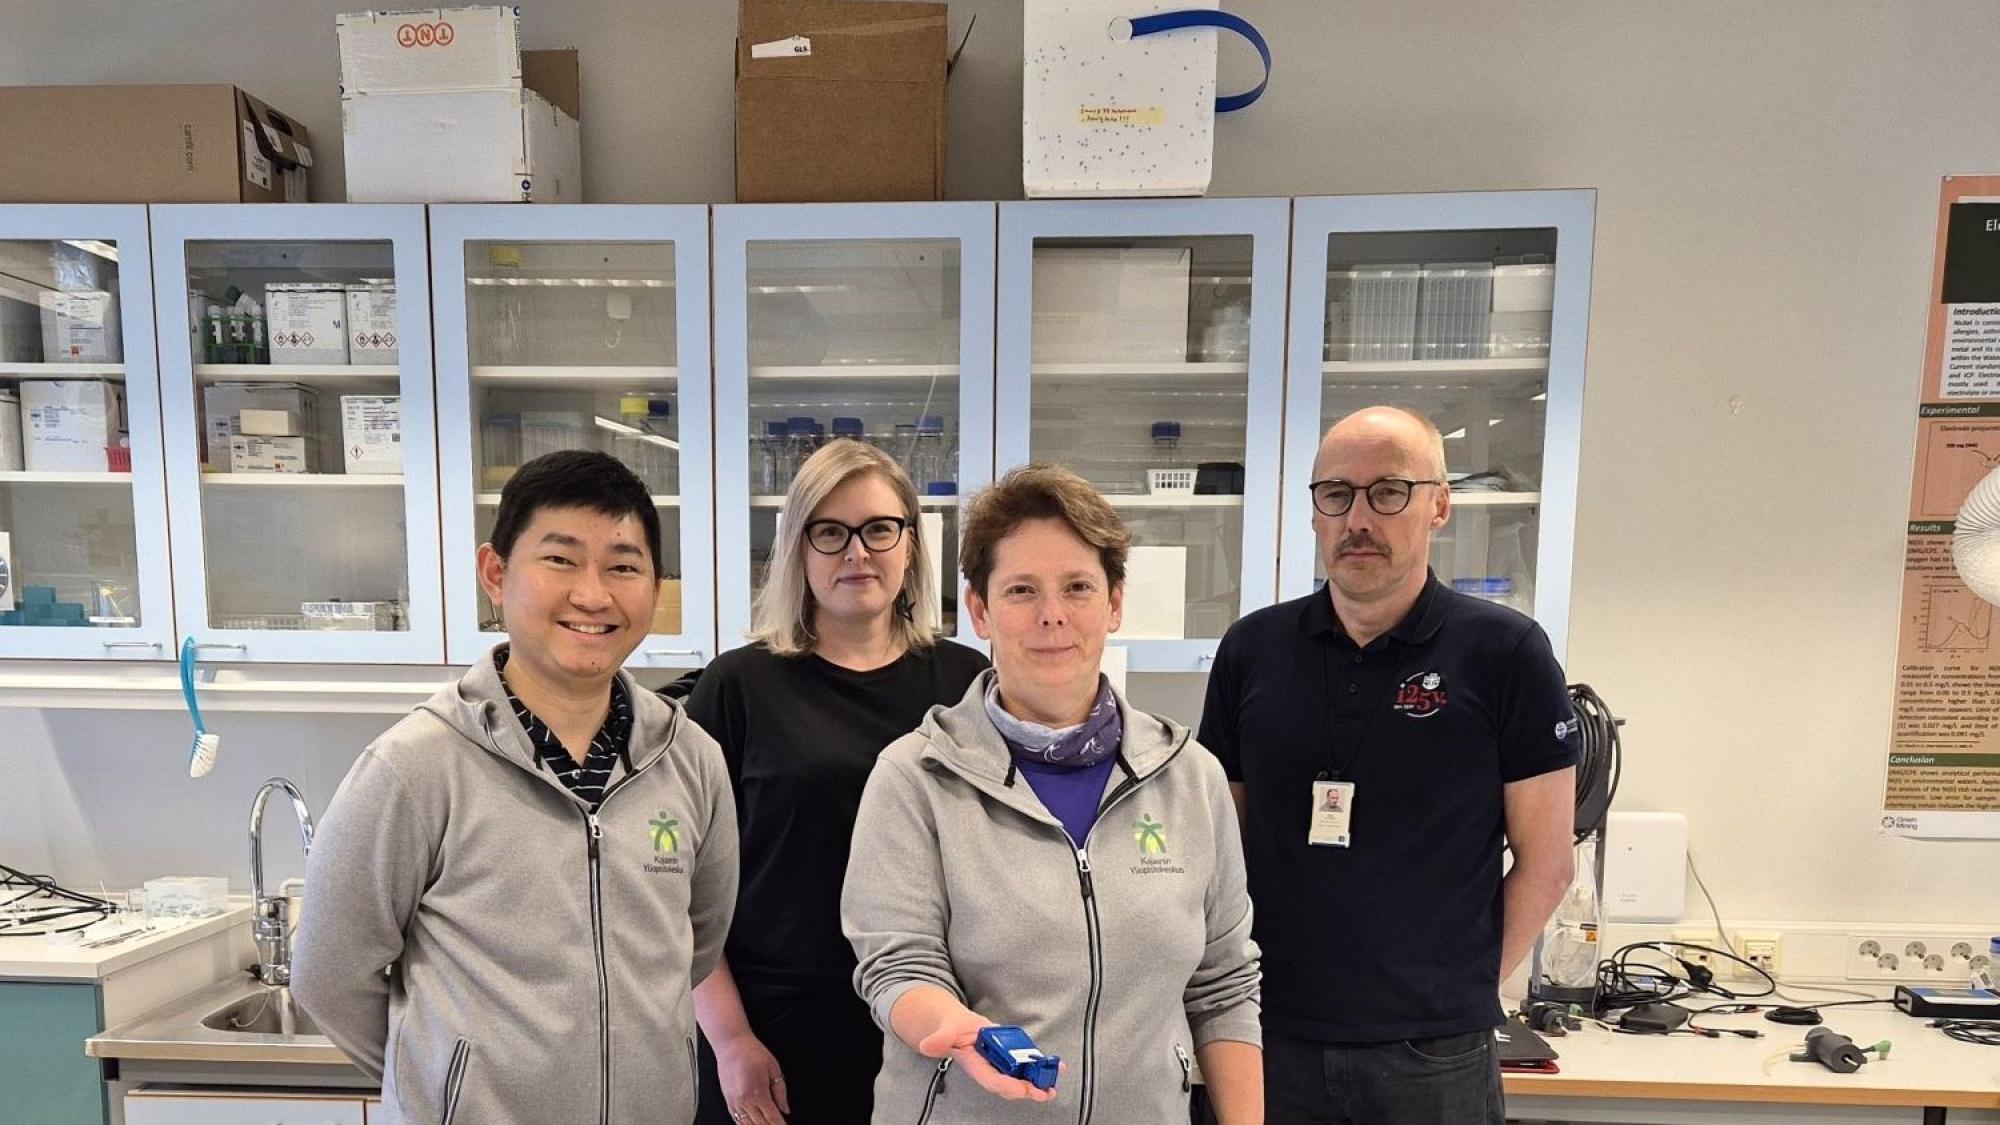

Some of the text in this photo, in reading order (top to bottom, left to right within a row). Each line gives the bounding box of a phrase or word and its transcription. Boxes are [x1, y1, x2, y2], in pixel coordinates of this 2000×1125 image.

[399, 25, 451, 44] TNT
[1921, 406, 1980, 416] Experimental
[1909, 524, 1940, 532] Results
[1396, 684, 1432, 711] 125
[1890, 756, 1935, 764] Conclusion
